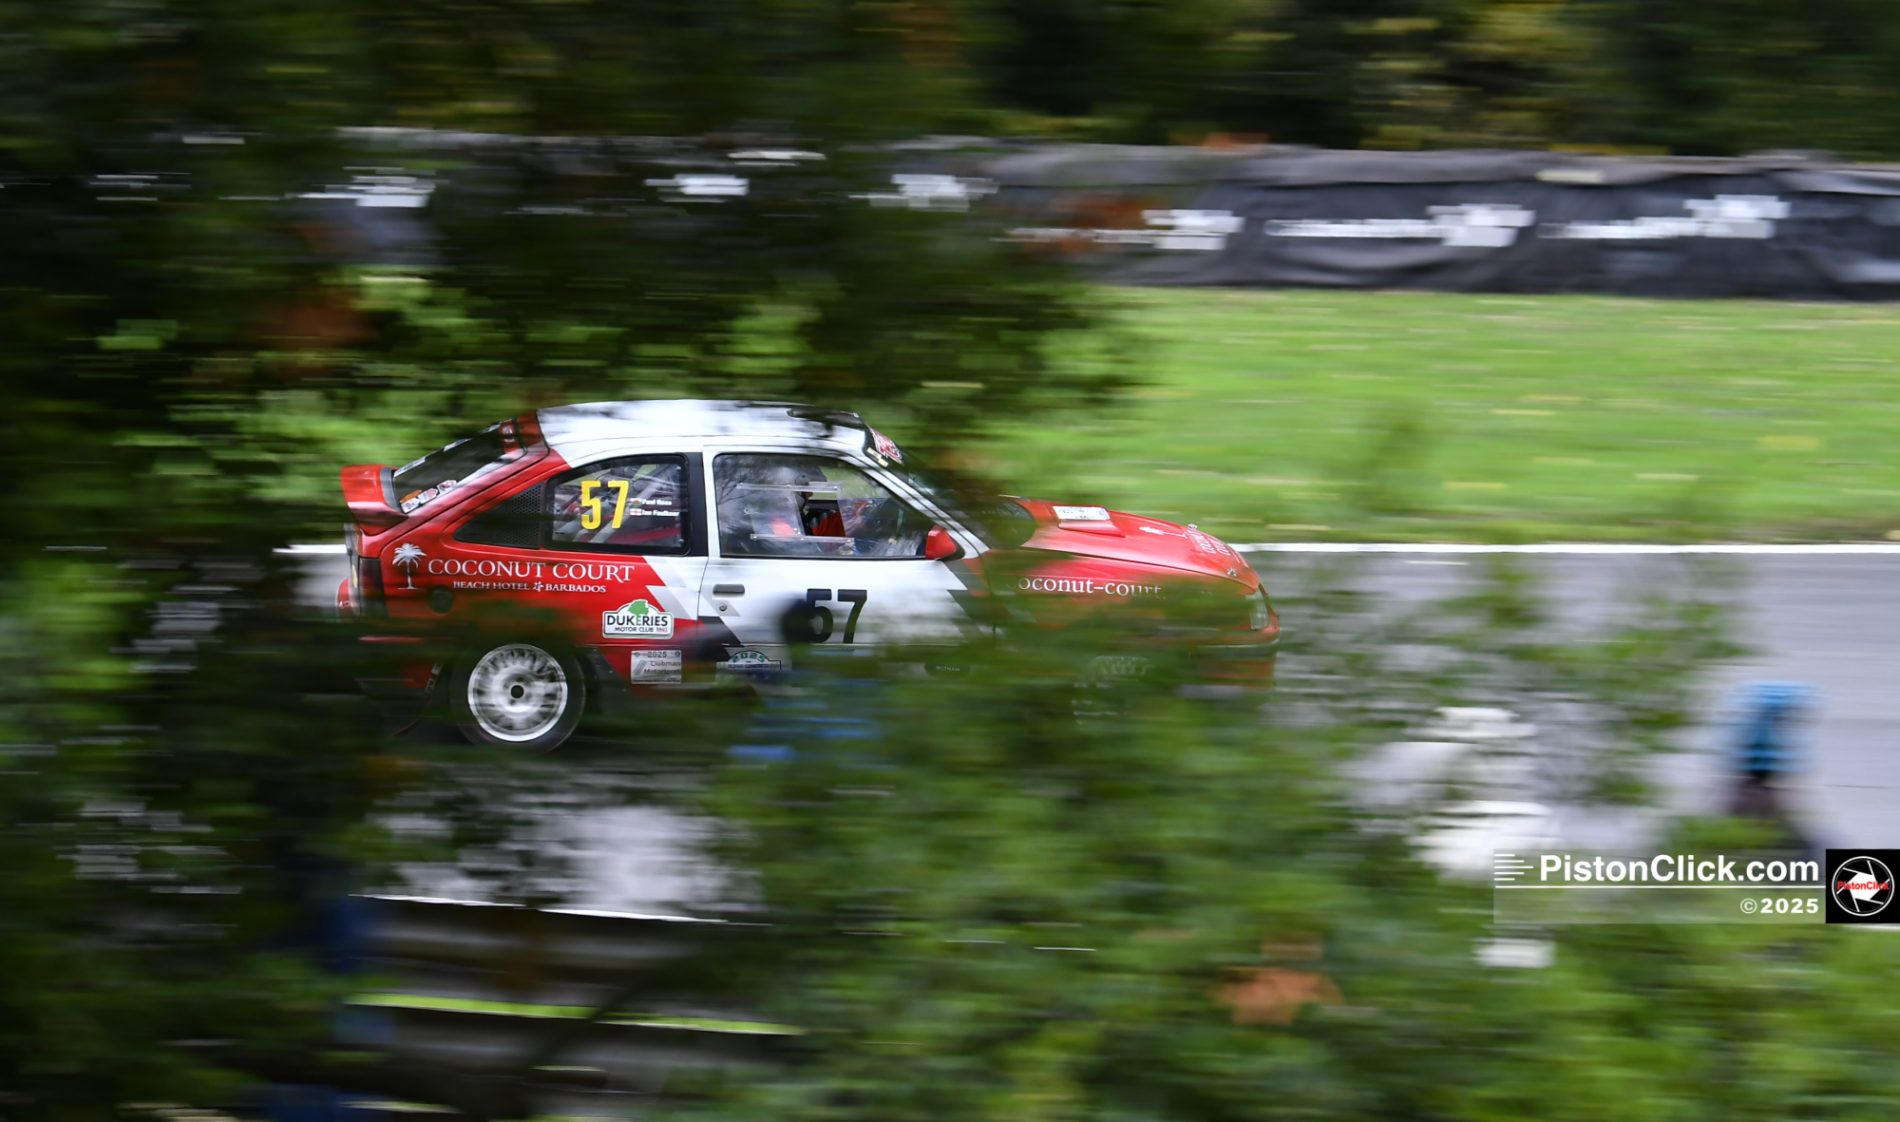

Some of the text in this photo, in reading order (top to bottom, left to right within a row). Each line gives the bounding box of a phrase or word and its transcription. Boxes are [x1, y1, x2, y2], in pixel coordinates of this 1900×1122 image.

[581, 480, 630, 530] 57
[428, 558, 635, 584] COCONUT COURT
[453, 580, 607, 593] BEACH HOTEL BARBADOS
[606, 615, 669, 627] DUKERIES
[806, 588, 868, 644] 57
[732, 652, 766, 663] 2025
